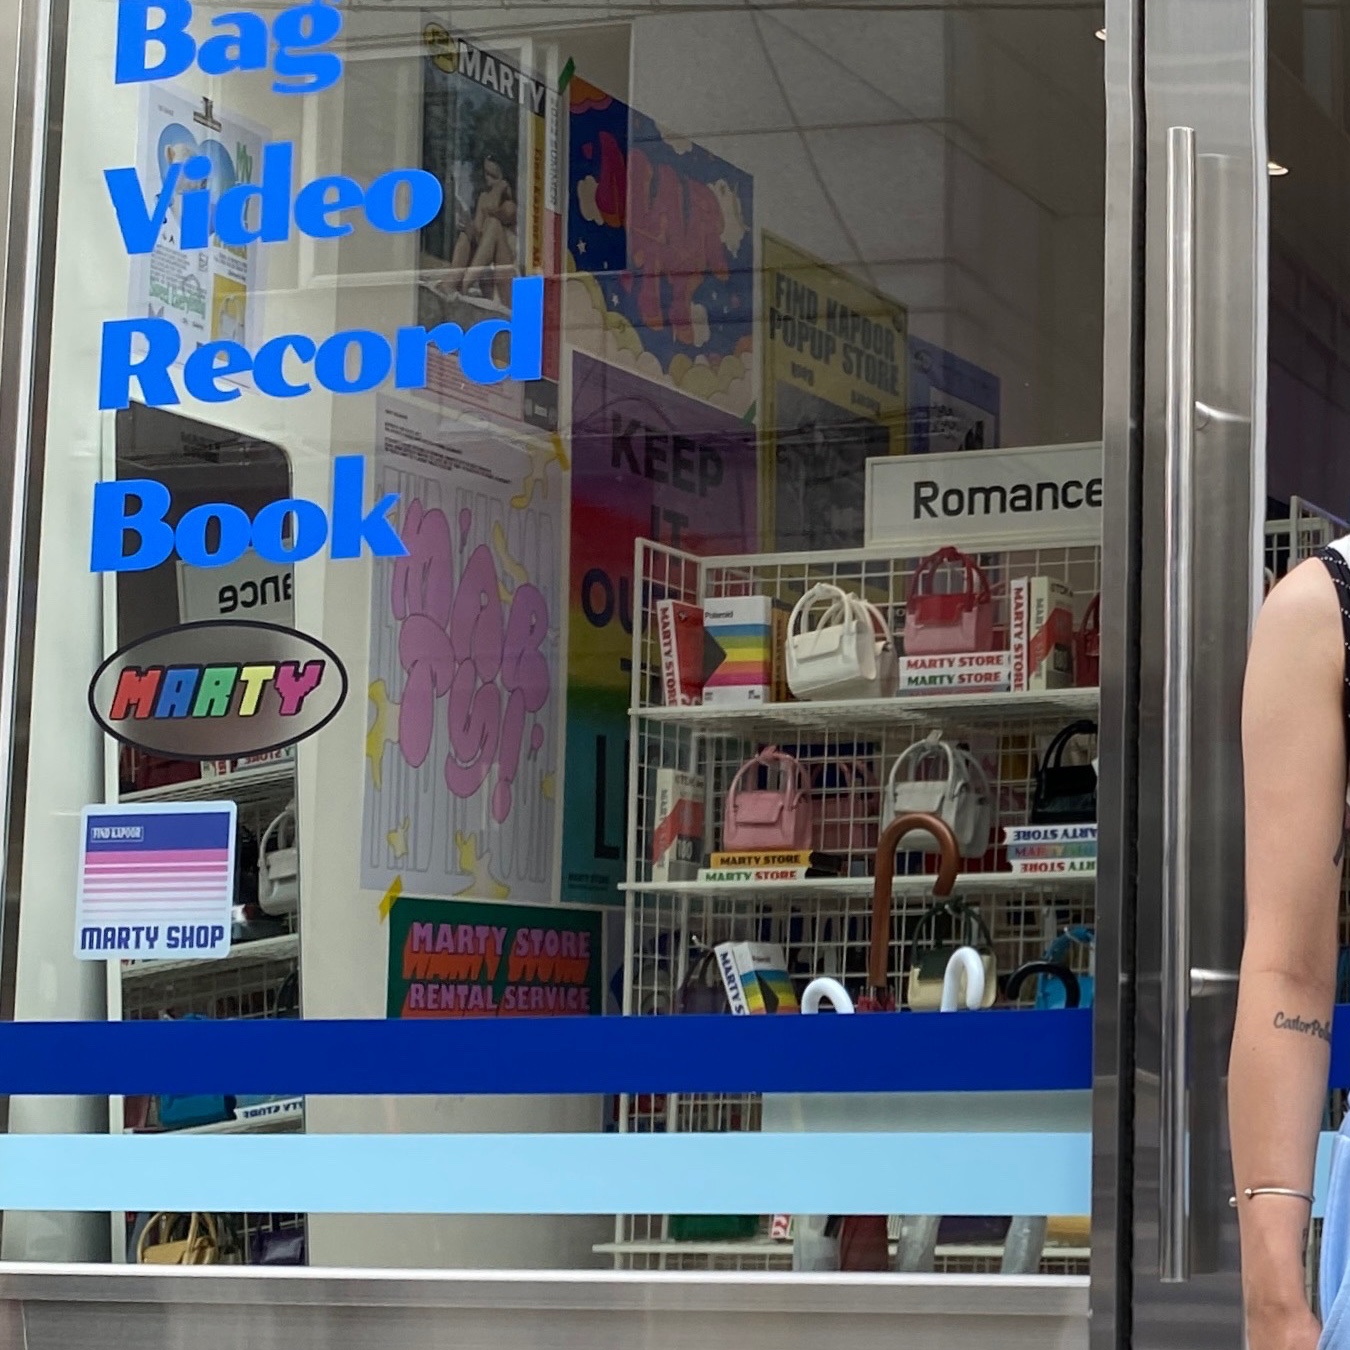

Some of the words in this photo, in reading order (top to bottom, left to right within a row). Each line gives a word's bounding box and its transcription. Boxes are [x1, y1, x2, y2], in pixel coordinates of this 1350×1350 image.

[115, 0, 343, 94] Bag
[459, 41, 545, 113] MARTY
[104, 141, 443, 255] Video
[775, 272, 818, 325] FIND
[826, 297, 895, 362] KAPOOR
[98, 276, 544, 410] Record
[770, 307, 837, 366] POPUP
[843, 343, 899, 397] STORE
[611, 410, 723, 498] KEEP
[90, 455, 409, 572] Book
[914, 477, 1102, 519] Romance
[660, 606, 673, 658] MARTY
[1013, 587, 1024, 640] MARTY
[665, 661, 678, 705] STORE
[906, 656, 955, 671] MARTY
[958, 655, 1004, 667] STORE
[907, 673, 955, 686] MARTY
[957, 671, 1002, 683] STORE
[1013, 643, 1024, 692] STORE
[109, 659, 326, 720] MARTY
[92, 827, 110, 839] FIND
[111, 827, 141, 838] KAPOOR
[1013, 830, 1058, 841] STORE
[705, 871, 752, 883] MARTY
[754, 870, 797, 881] STORE
[720, 855, 760, 867] MARTY
[763, 854, 800, 866] STORE
[1020, 862, 1066, 873] STORE
[81, 925, 159, 950] MARTY
[166, 925, 224, 949] SHOP
[412, 922, 507, 955] MARTY
[515, 928, 591, 958] STORE
[409, 983, 498, 1010] RENTAL
[504, 986, 591, 1010] SERVICE
[720, 950, 741, 1001] MARTY
